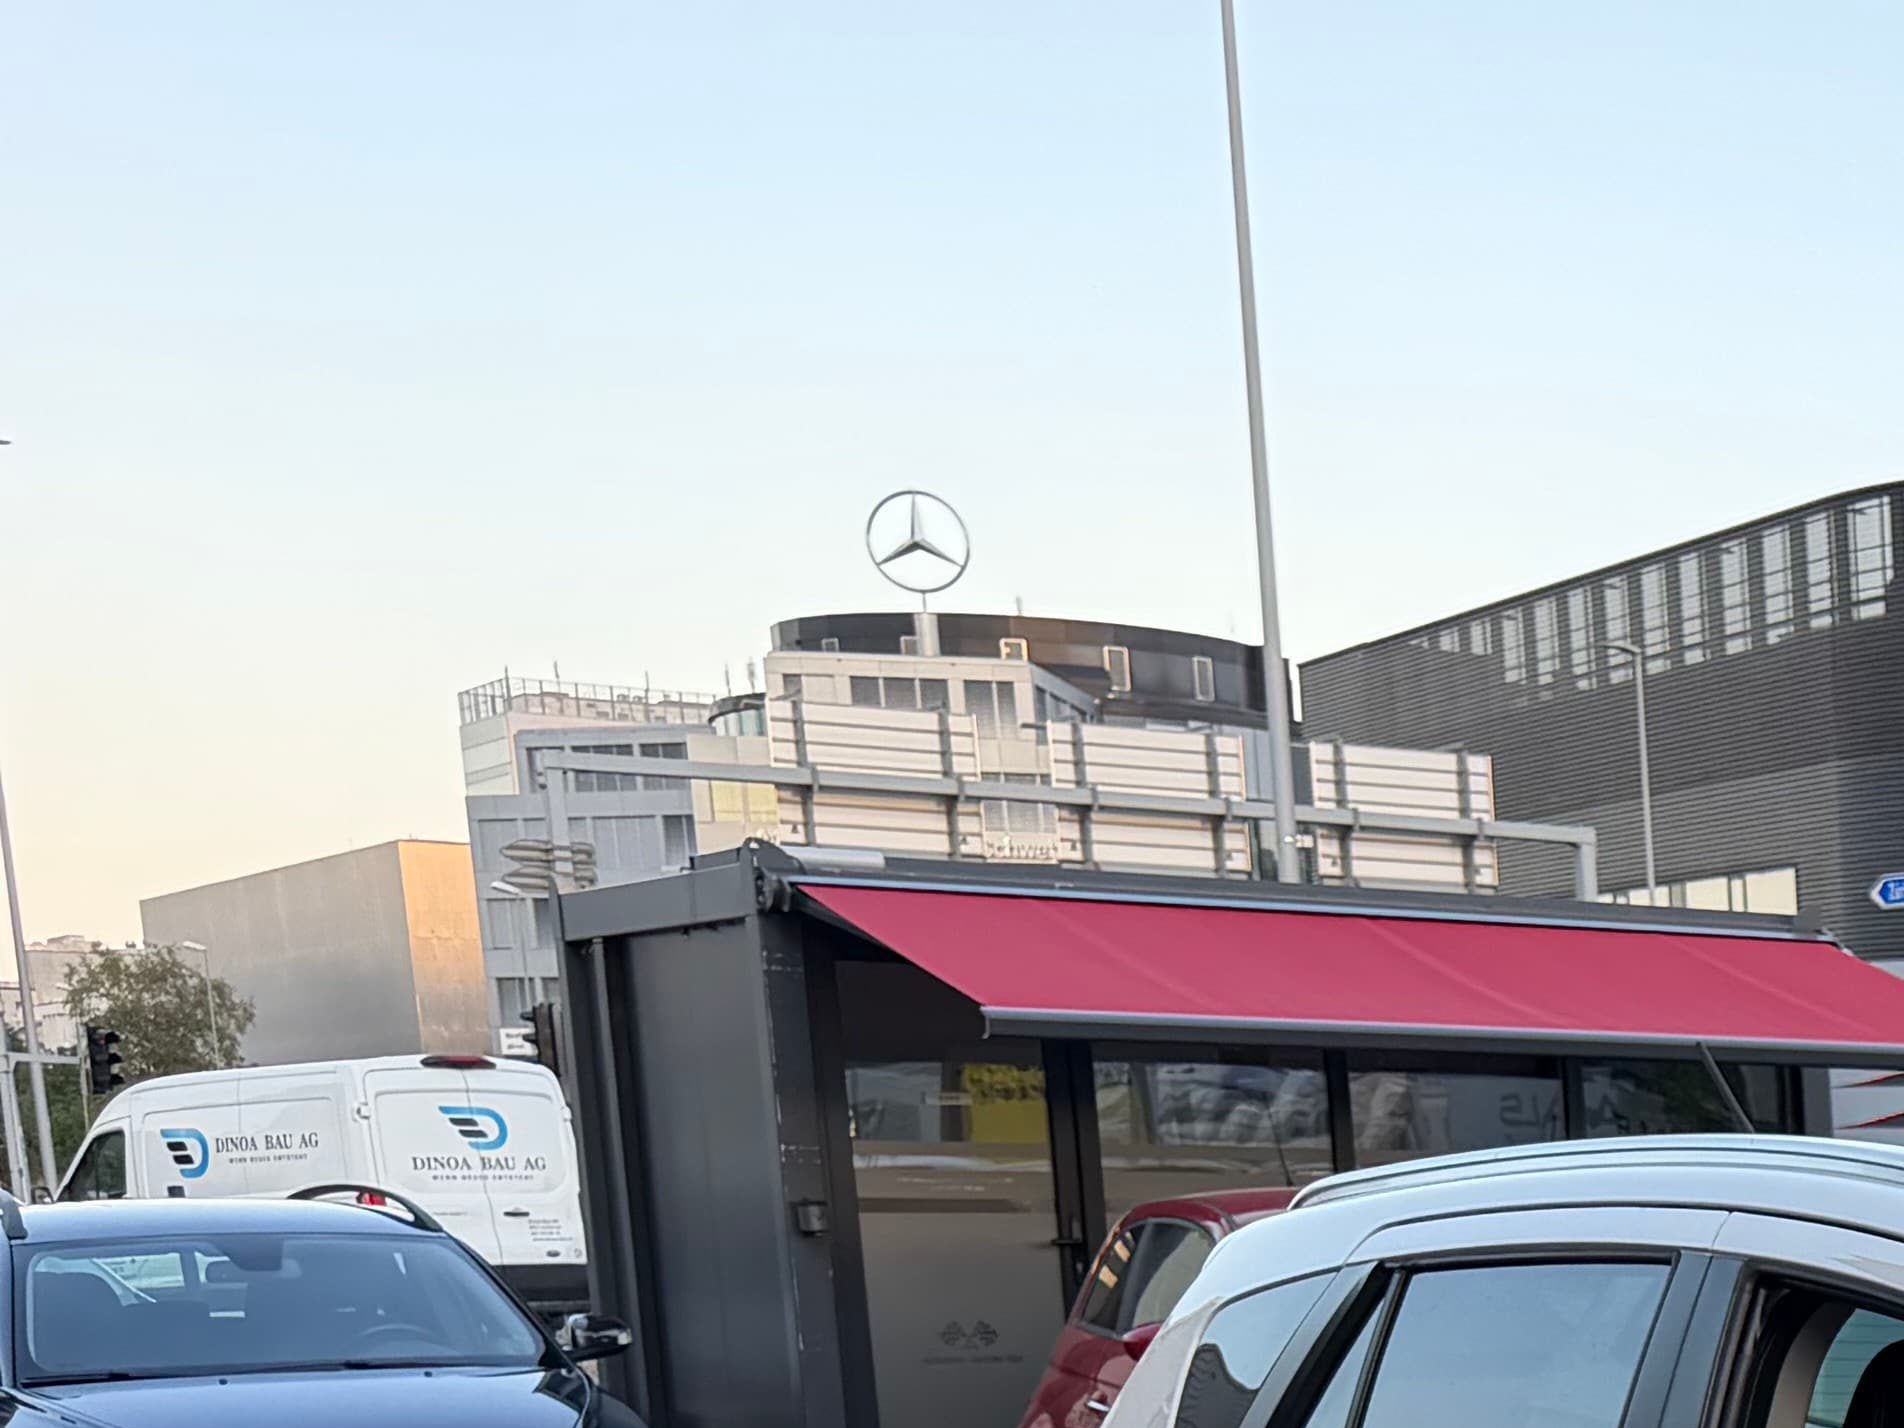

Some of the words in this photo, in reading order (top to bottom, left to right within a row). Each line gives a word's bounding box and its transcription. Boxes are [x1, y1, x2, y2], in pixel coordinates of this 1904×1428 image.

[216, 1136, 258, 1154] DINOA
[265, 1133, 293, 1151] BAU
[299, 1132, 319, 1149] AG
[412, 1156, 472, 1171] DINOA
[480, 1156, 516, 1171] BAU
[524, 1156, 546, 1171] AG
